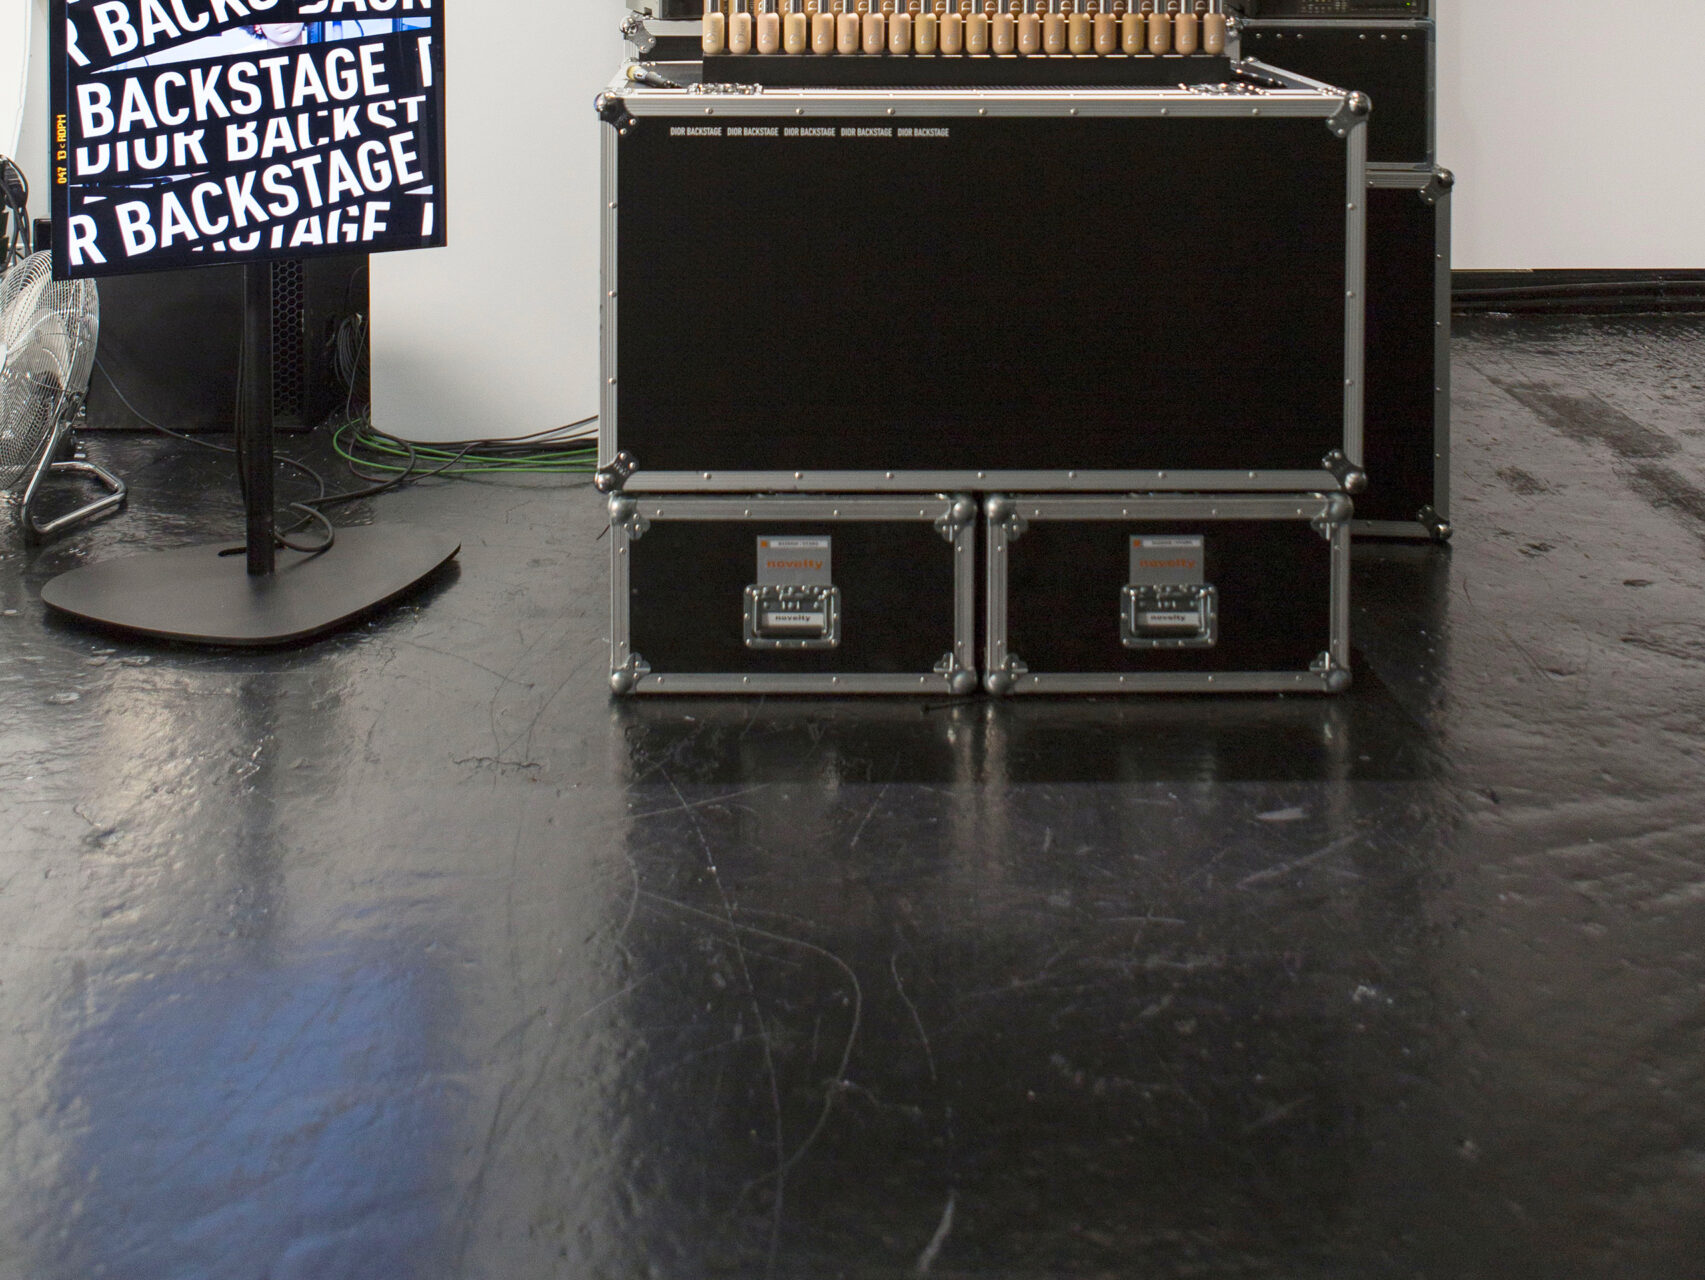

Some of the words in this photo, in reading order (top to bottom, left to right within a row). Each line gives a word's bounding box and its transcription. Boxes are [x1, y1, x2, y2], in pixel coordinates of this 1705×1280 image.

[76, 42, 390, 139] BACKSTAGE
[670, 127, 686, 136] DIOR
[687, 127, 722, 136] BACKSTAGE
[727, 127, 742, 136] DIOR
[743, 127, 779, 136] BACKSTAGE
[784, 127, 799, 136] DIOR
[800, 127, 836, 136] BACKSTAGE
[841, 128, 856, 137] DIOR
[857, 128, 893, 137] BACKSTAGE
[897, 128, 913, 137] DIOR
[914, 128, 950, 137] BACKSTAGE
[56, 150, 67, 161] 13
[57, 166, 67, 185] 047
[69, 214, 107, 266] R
[115, 130, 424, 257] BACKSTAGE
[767, 559, 823, 570] novelty
[1139, 558, 1196, 569] novelty
